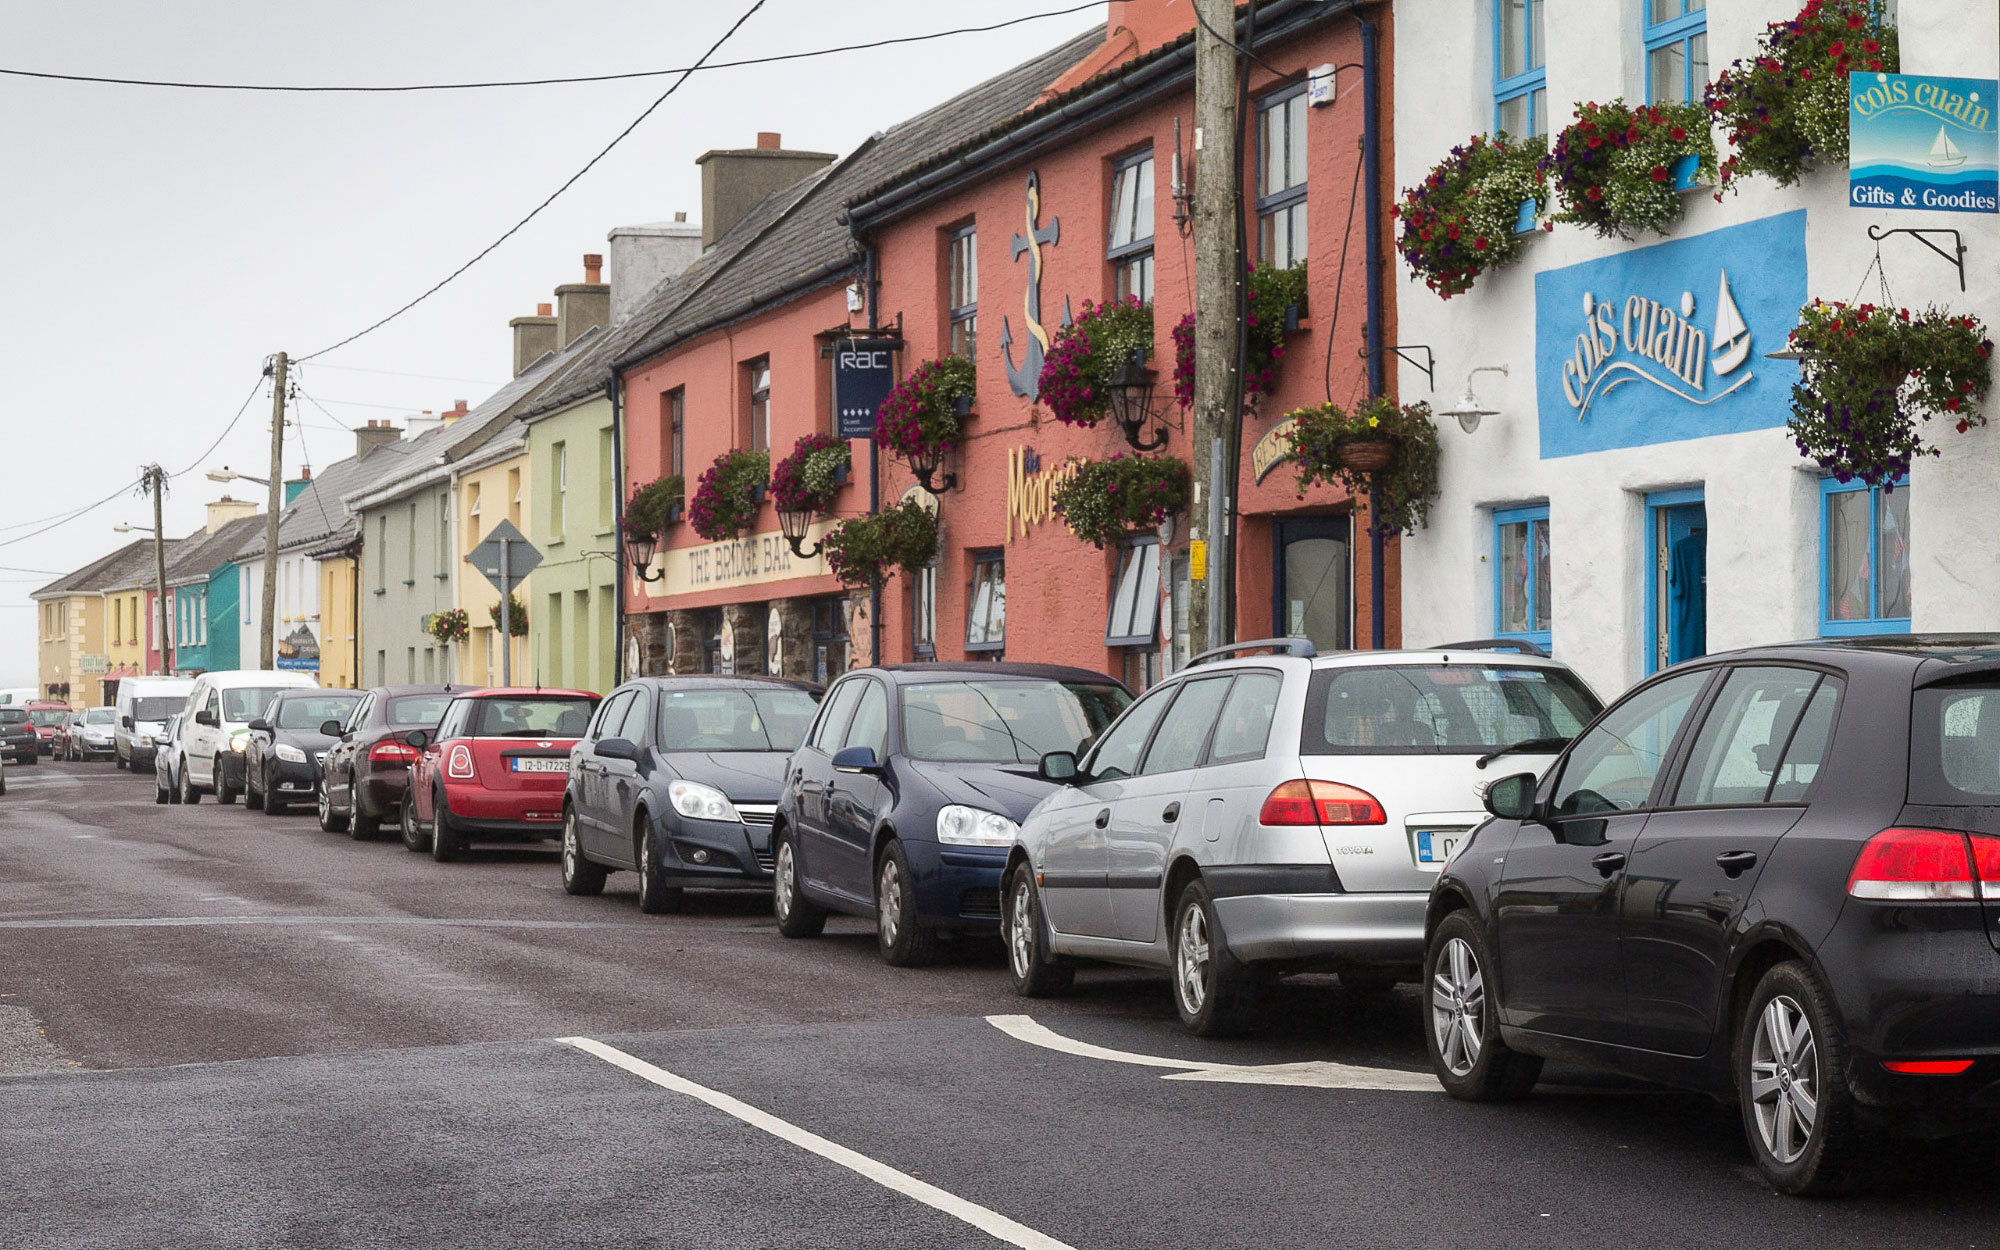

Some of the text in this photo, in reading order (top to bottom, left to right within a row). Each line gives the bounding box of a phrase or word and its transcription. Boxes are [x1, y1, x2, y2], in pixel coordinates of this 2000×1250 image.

[1853, 72, 1990, 131] cois cuain
[1852, 185, 1996, 210] Gifts & Goodies
[1562, 290, 1706, 409] cois cuain
[688, 535, 792, 586] THE BRIDGE BAR
[1335, 845, 1374, 855] TOYOTA
